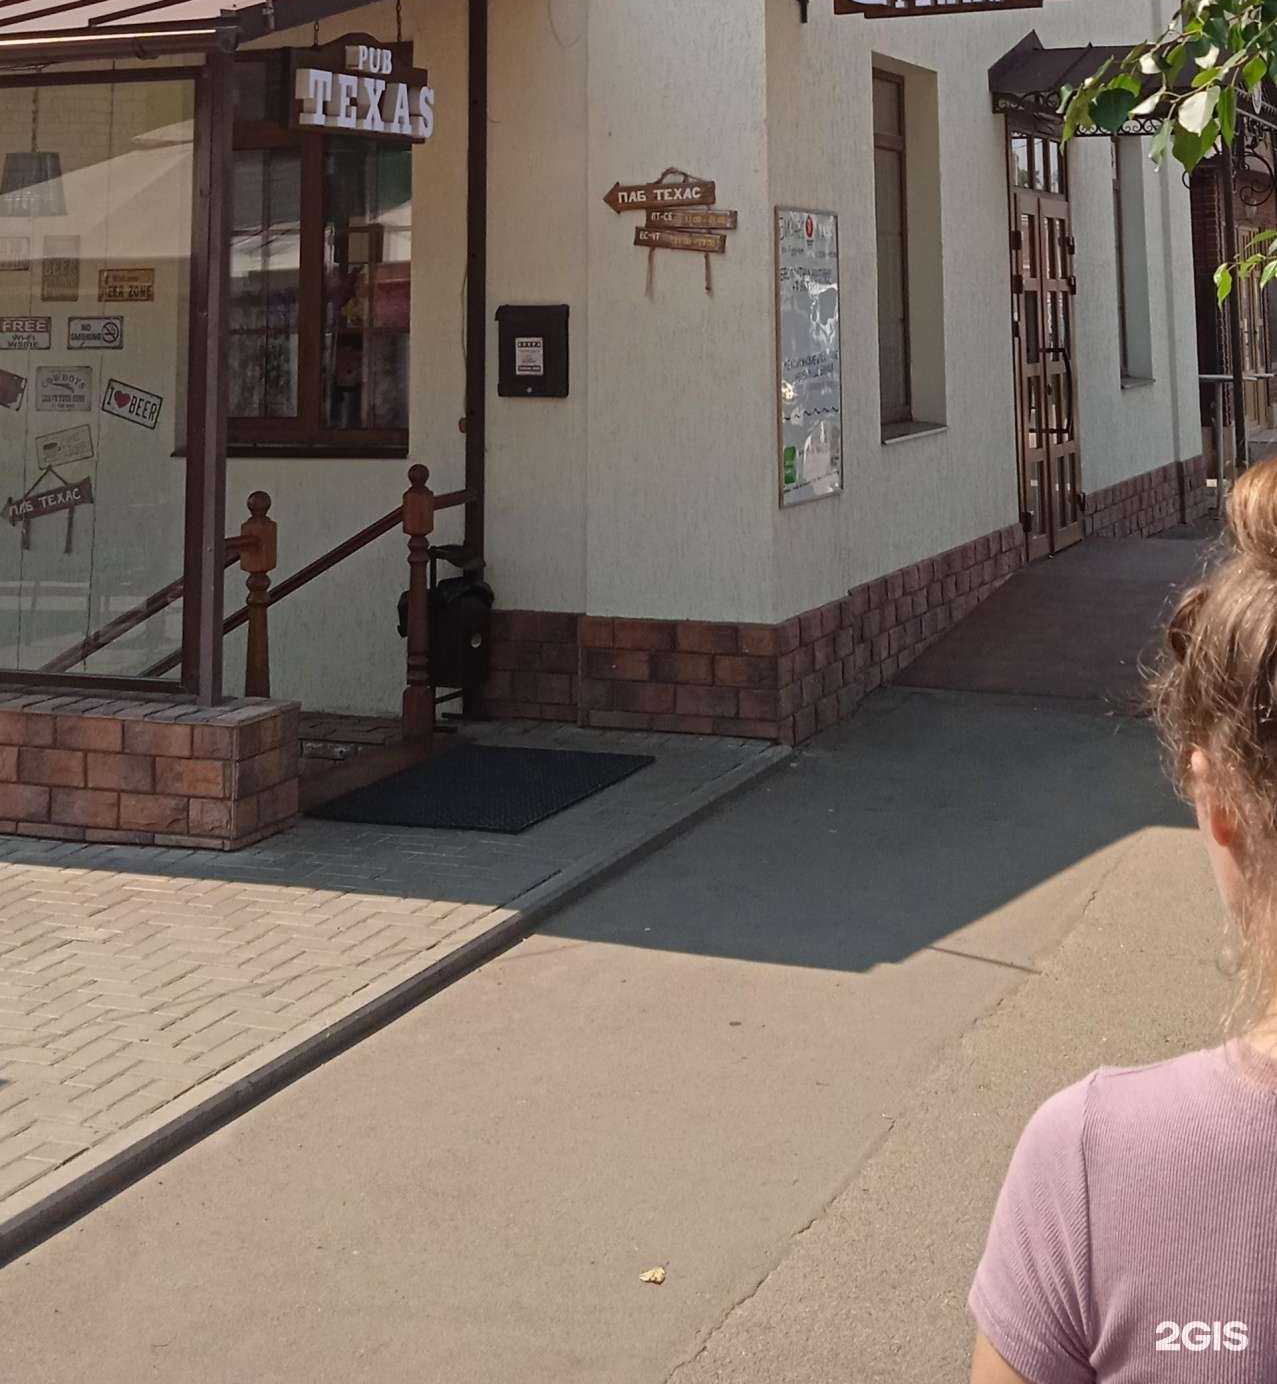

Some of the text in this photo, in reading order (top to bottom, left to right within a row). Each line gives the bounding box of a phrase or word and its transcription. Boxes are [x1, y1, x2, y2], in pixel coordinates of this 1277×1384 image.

[356, 45, 392, 75] PUB
[307, 69, 434, 138] TEXAS
[618, 187, 701, 204] ПАБ ТЕХАС
[3, 320, 48, 332] FREE
[106, 386, 157, 422] I BEER
[9, 488, 81, 517] ПАБ ТЕХАС
